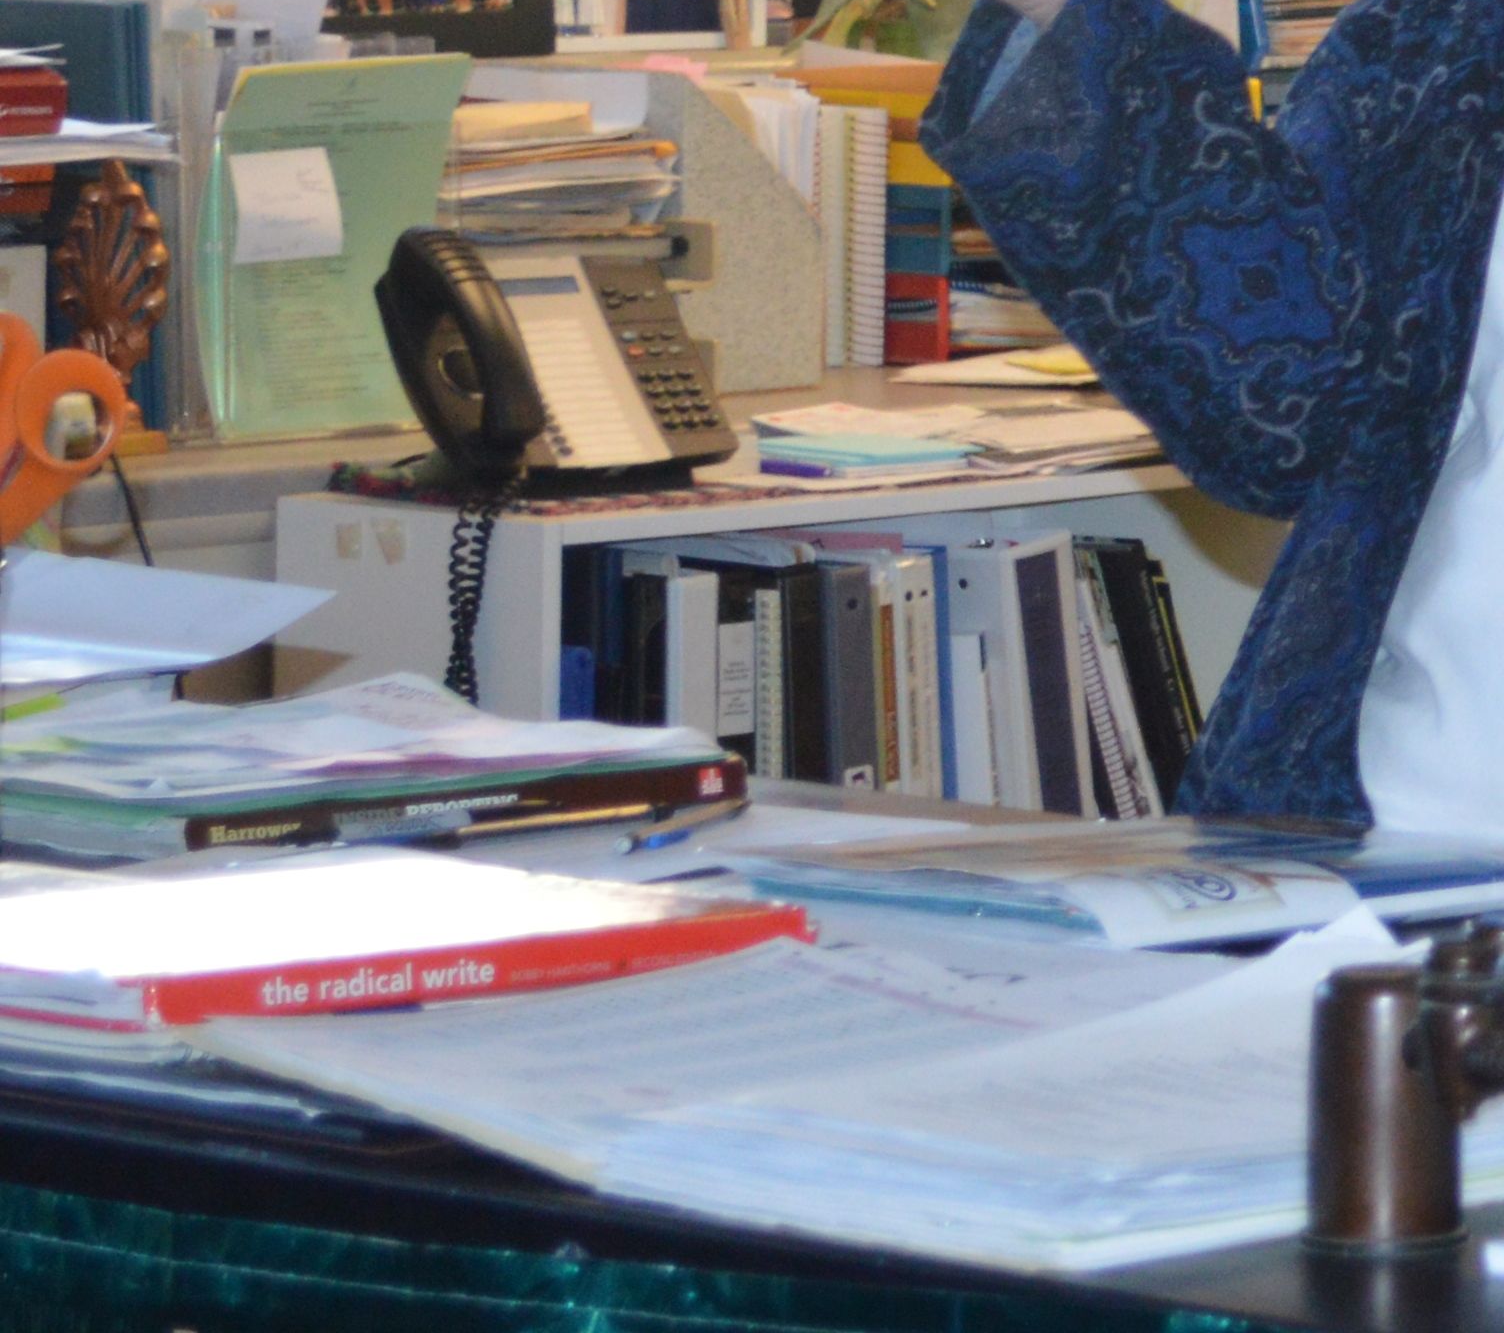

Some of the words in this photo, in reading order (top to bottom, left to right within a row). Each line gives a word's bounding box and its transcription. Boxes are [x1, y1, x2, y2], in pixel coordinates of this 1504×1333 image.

[261, 975, 310, 1007] the
[319, 961, 414, 1001] radical
[421, 958, 496, 990] write
